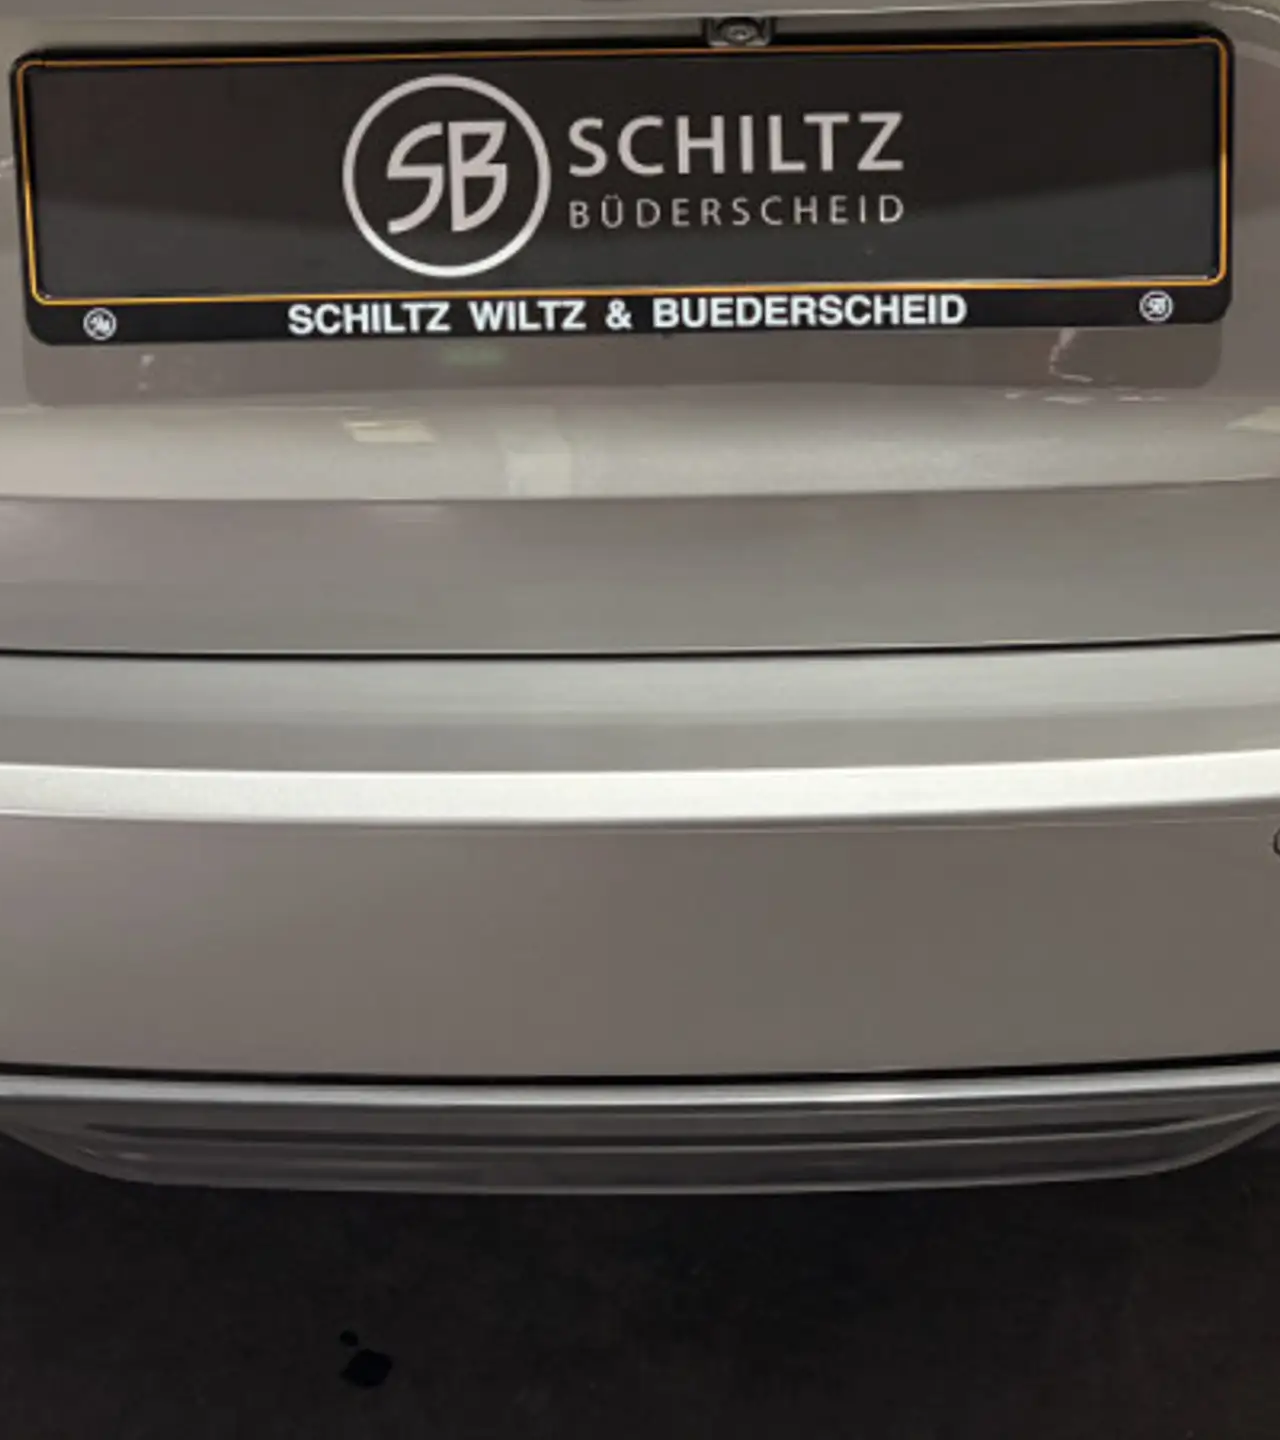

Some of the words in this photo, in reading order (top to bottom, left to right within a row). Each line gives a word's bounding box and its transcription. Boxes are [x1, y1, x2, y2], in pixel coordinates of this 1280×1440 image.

[568, 112, 904, 177] SCHILTZ
[570, 195, 905, 229] BÜDERSCHEID
[287, 302, 451, 335] SCHILTZ
[468, 300, 587, 331] WILTZ
[605, 302, 633, 329] &
[652, 293, 968, 328] BUEDERSCHEID
